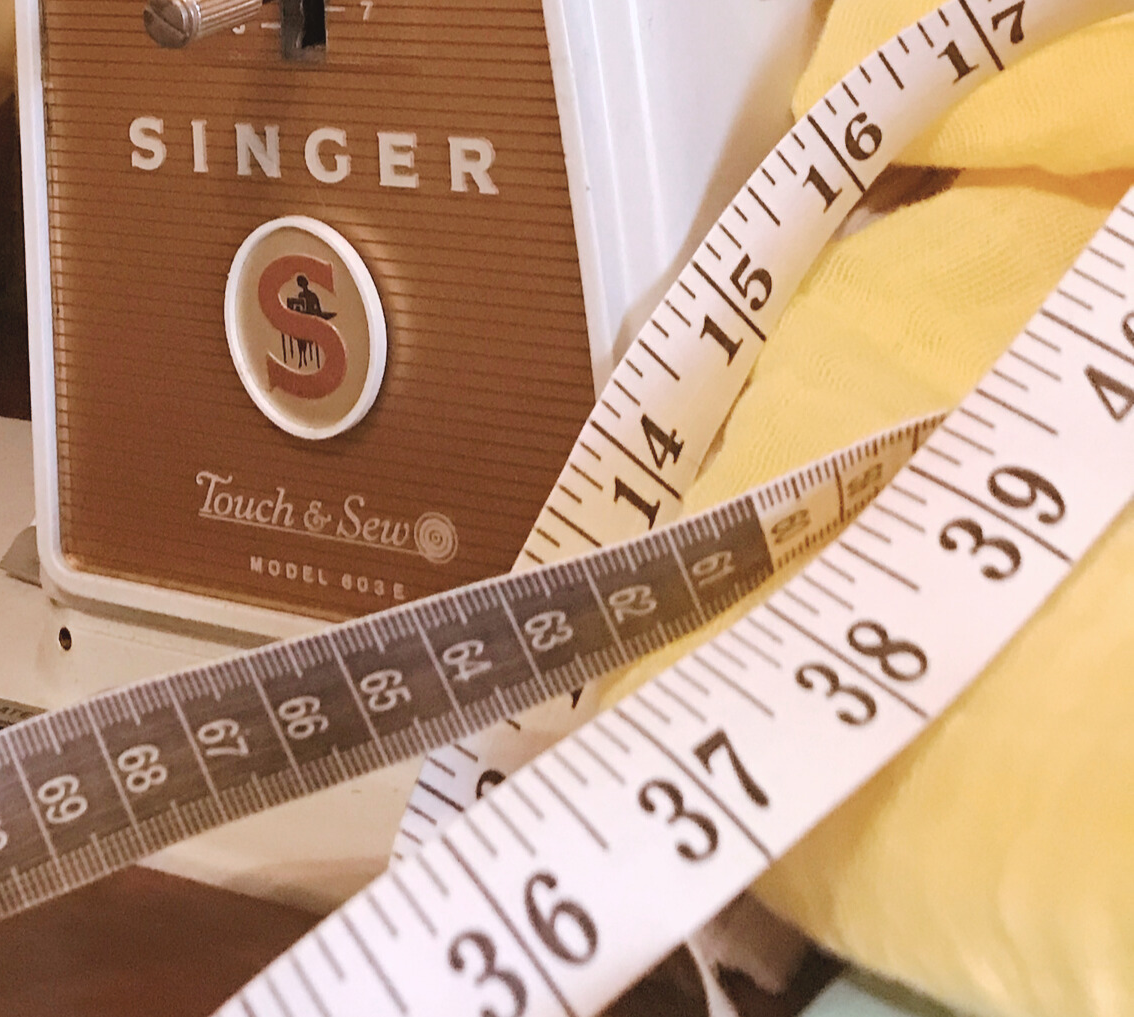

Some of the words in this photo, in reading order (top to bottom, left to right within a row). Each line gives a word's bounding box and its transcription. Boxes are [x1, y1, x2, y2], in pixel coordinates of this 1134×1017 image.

[360, 0, 374, 21] 7
[129, 116, 499, 195] SINGER
[613, 414, 684, 530] 14
[700, 253, 773, 366] 15
[803, 112, 883, 213] 16
[937, 0, 1027, 83] 17
[196, 470, 294, 526] Touch
[303, 500, 332, 532] &
[336, 494, 409, 546] Sew
[250, 555, 328, 586] MODEL
[693, 551, 736, 585] 61
[609, 585, 658, 624] 62
[525, 610, 573, 651] 63
[443, 640, 492, 681] 64
[360, 669, 412, 712] 65
[197, 718, 249, 759] 67
[278, 695, 329, 740] 66
[448, 870, 599, 1017] 36
[638, 728, 771, 862] 37
[796, 618, 929, 727] 38
[938, 463, 1068, 583] 39
[118, 744, 167, 793] 68
[38, 774, 88, 824] 69
